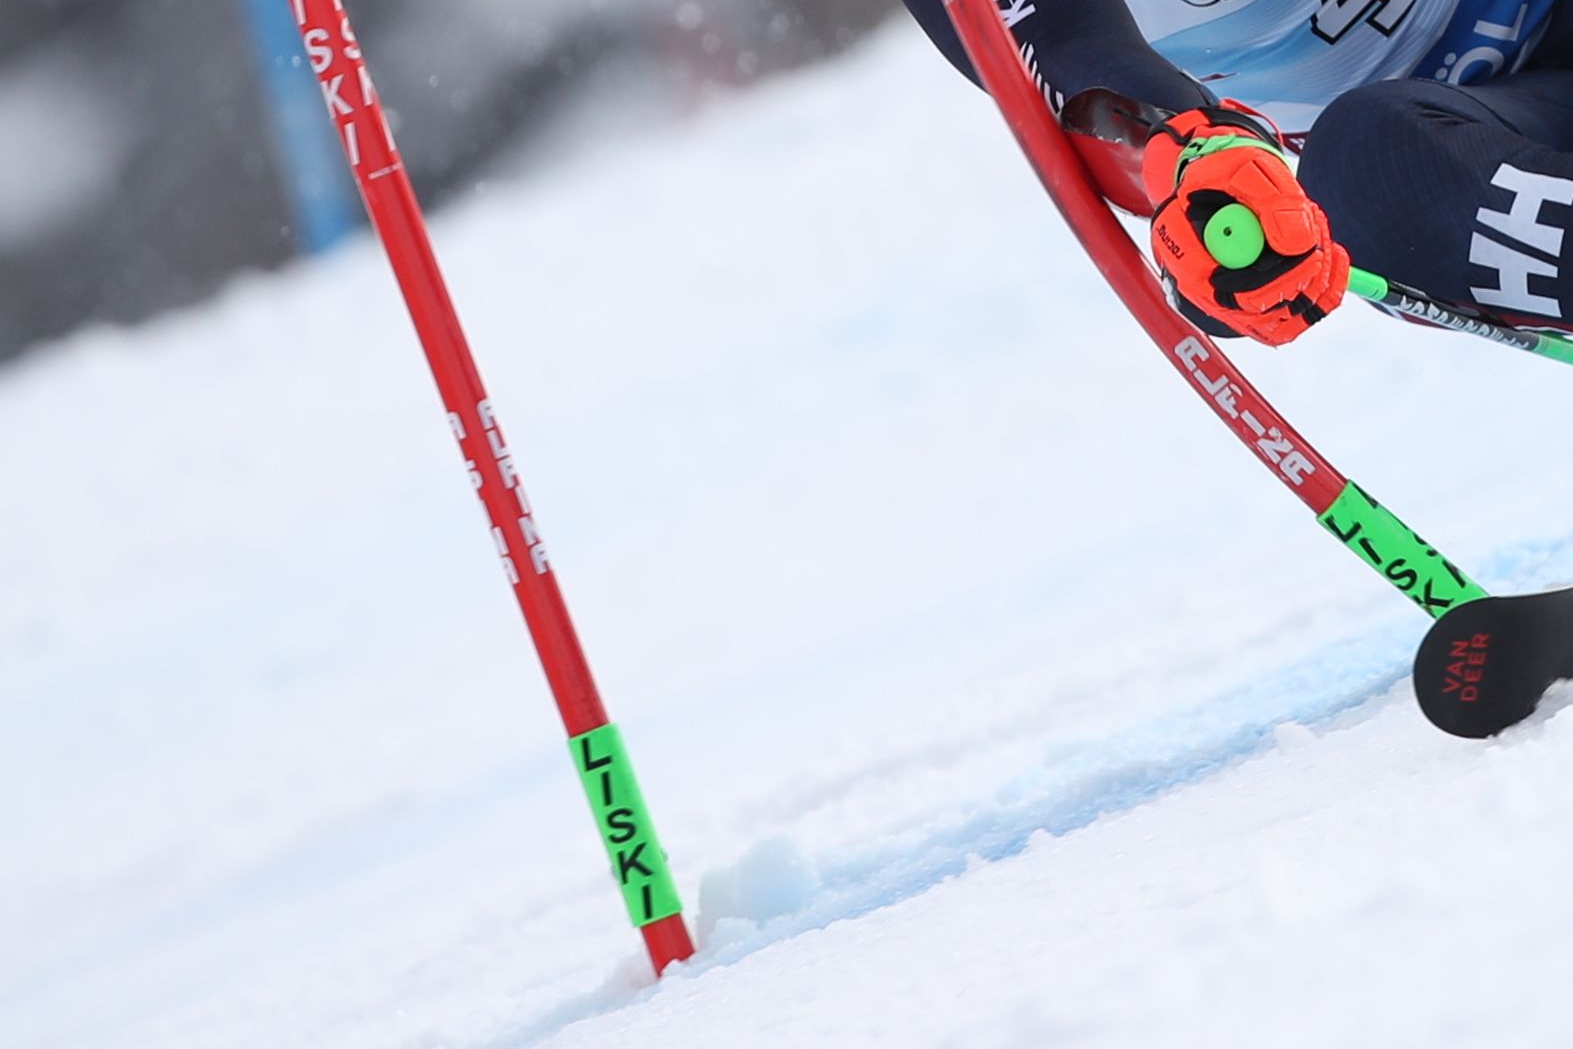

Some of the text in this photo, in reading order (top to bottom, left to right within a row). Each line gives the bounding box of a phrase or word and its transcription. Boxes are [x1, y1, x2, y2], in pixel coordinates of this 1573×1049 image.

[1325, 514, 1455, 619] LISK
[1442, 640, 1470, 694] VAN
[1459, 632, 1491, 703] DEER
[581, 737, 655, 921] LISKI
